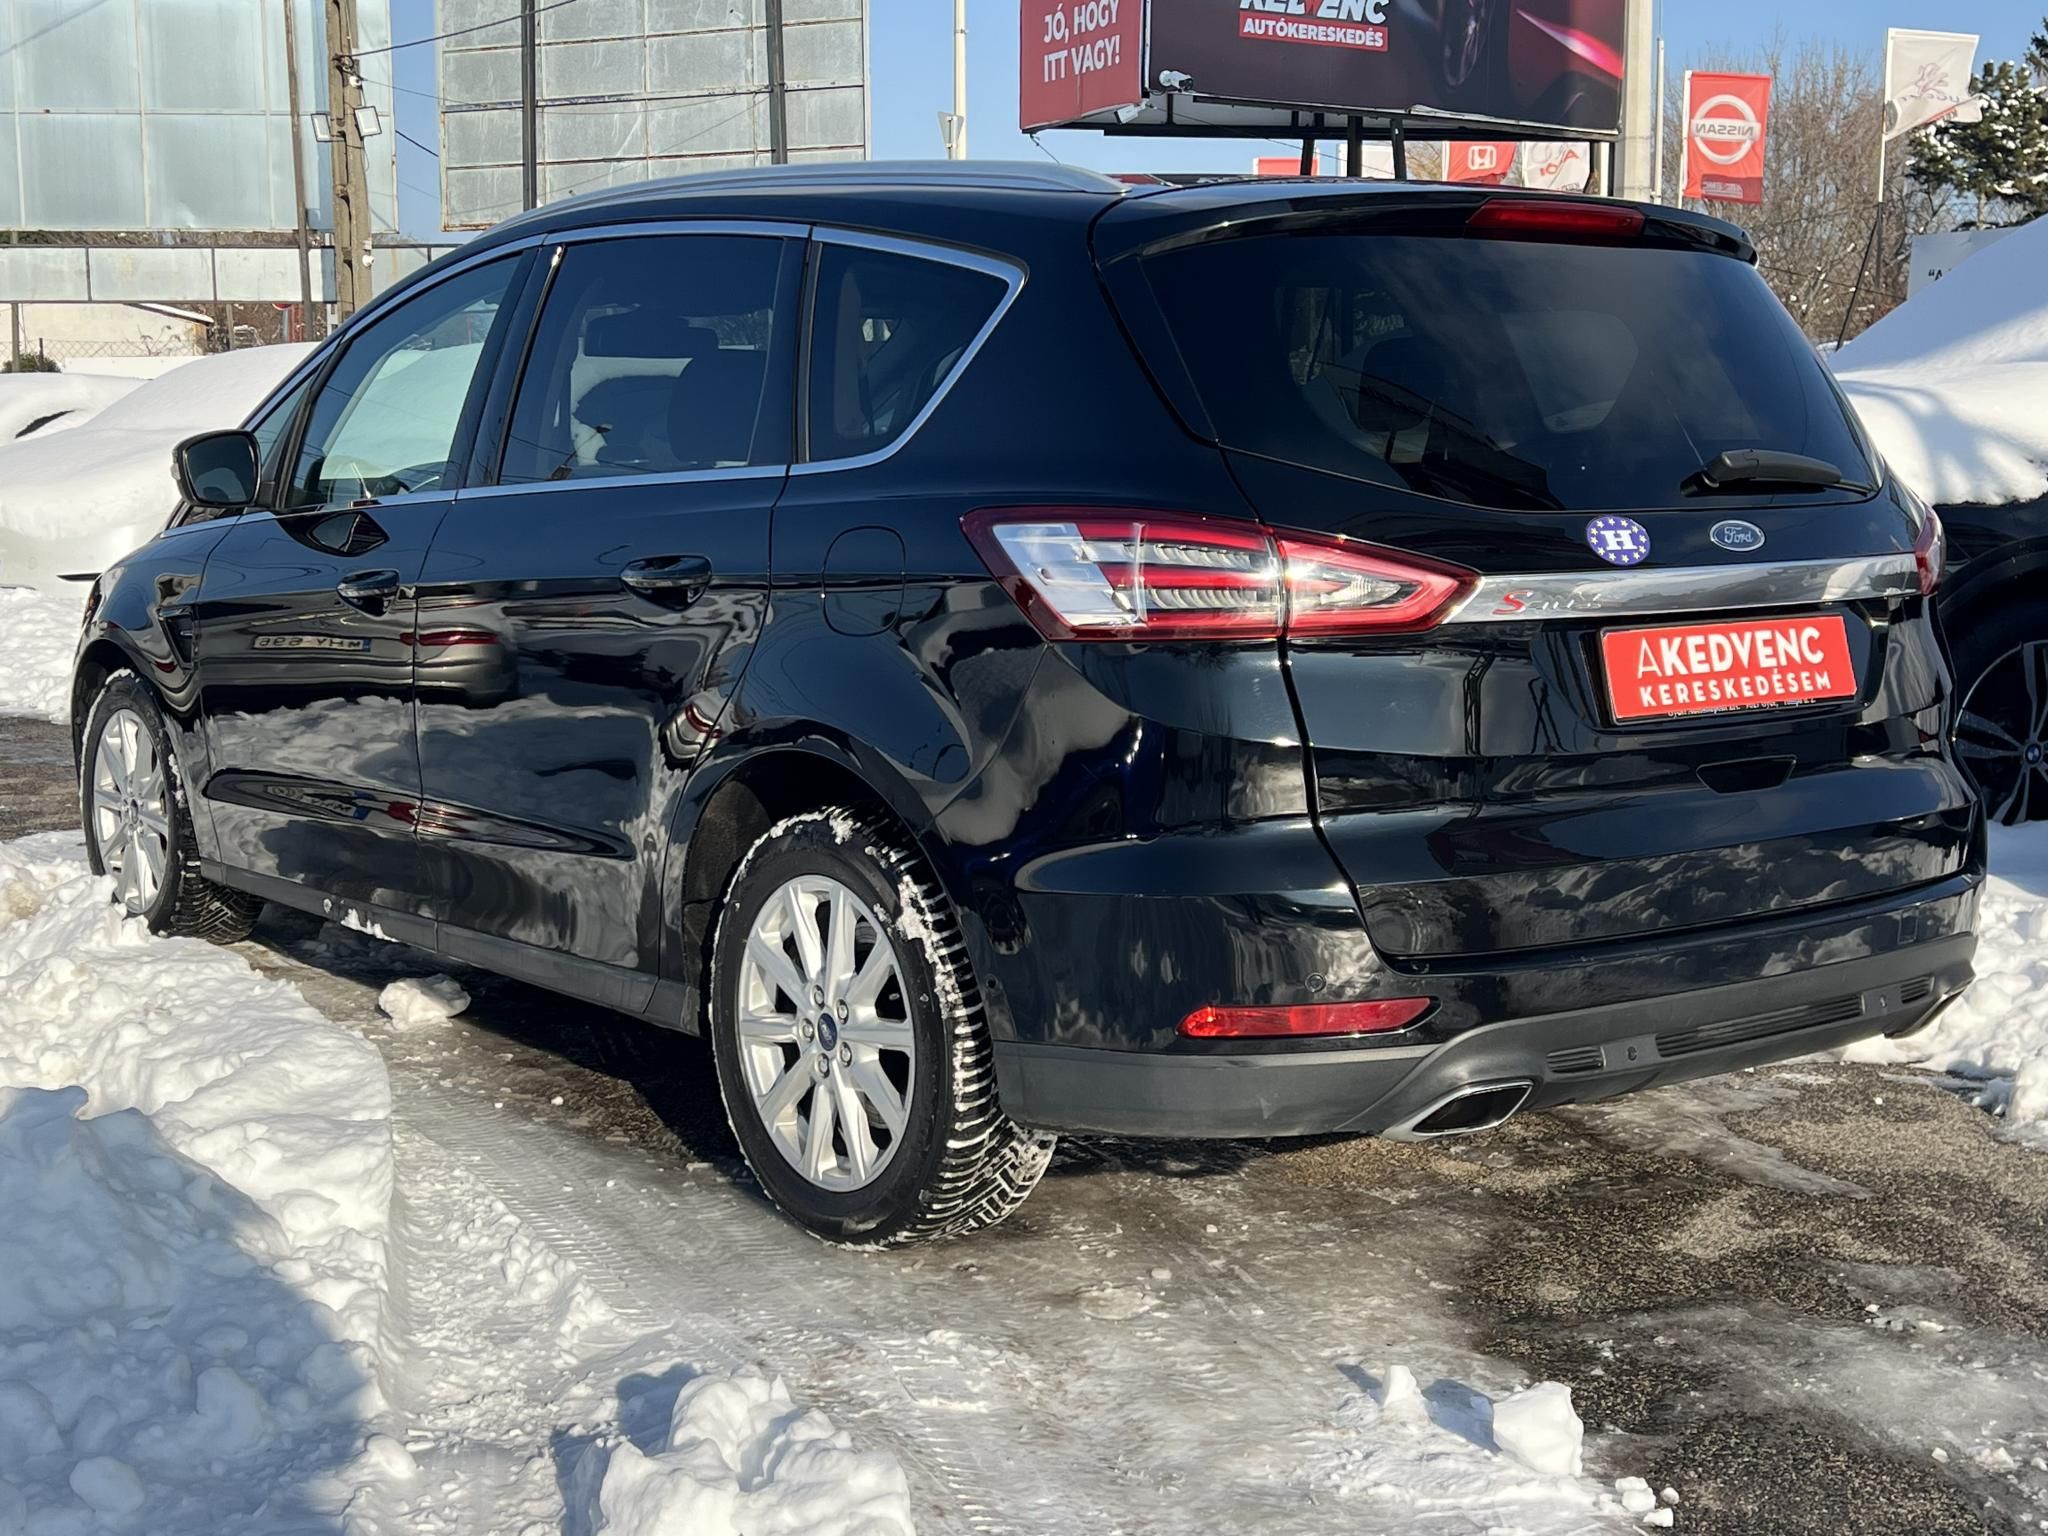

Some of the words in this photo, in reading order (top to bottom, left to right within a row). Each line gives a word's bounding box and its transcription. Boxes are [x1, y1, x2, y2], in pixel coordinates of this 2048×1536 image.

[1044, 3, 1069, 44] JÓ,
[1073, 0, 1120, 35] HOGY
[1243, 18, 1383, 47] AUTÓKERESKEDÉS
[1044, 49, 1068, 82] ITT
[1071, 34, 1120, 75] VAGY!
[1600, 529, 1637, 551] H
[1724, 526, 1753, 543] Ford
[1639, 668, 1832, 707] KERESKEDÉSEM
